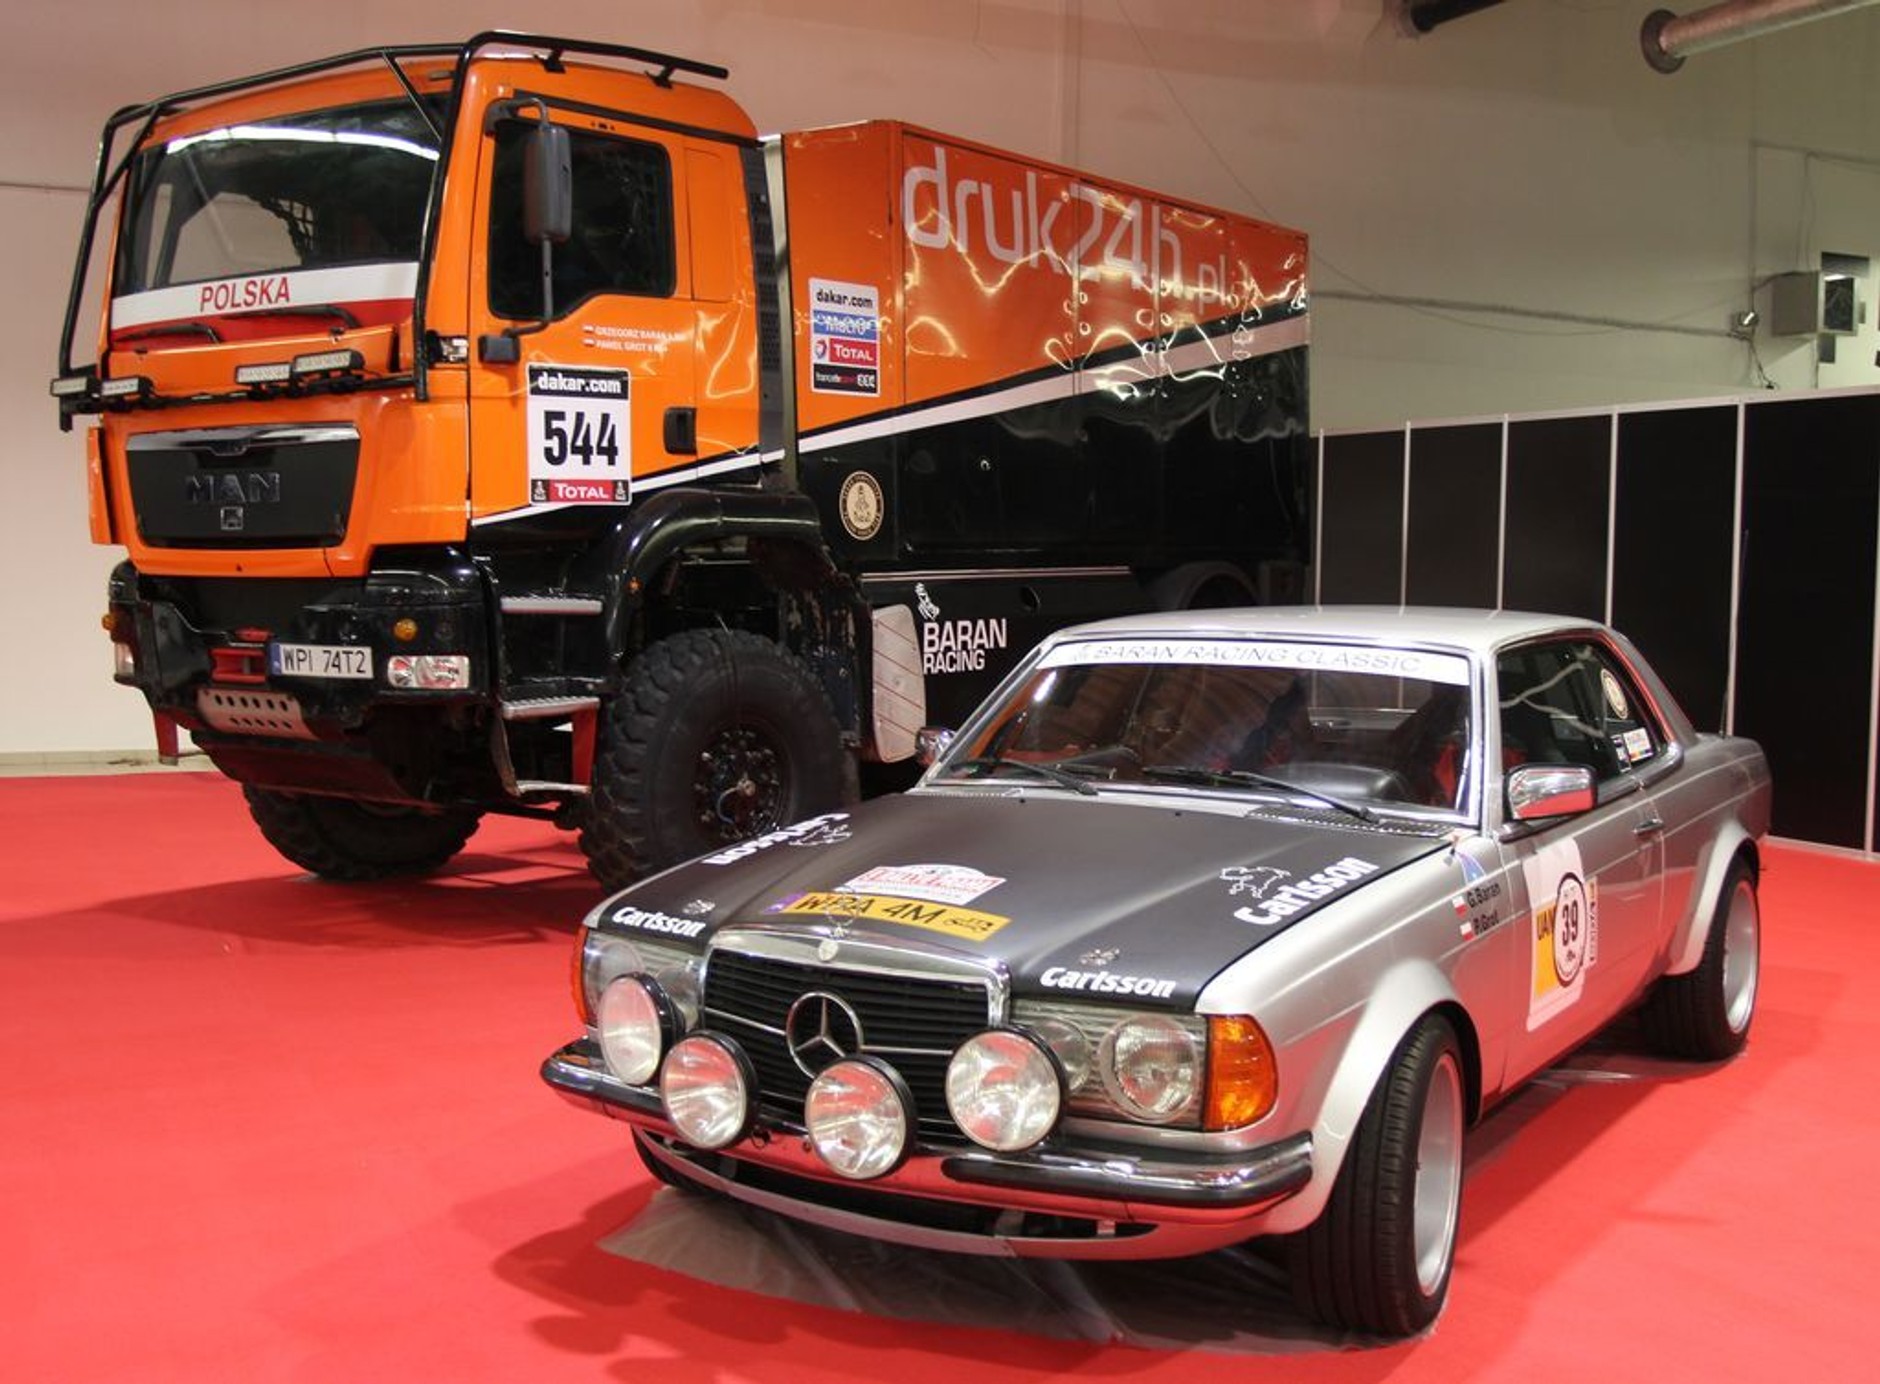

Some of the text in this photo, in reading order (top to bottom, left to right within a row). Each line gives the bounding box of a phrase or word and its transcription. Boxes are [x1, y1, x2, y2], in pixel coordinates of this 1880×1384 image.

[200, 276, 290, 312] POLSKA
[816, 289, 873, 308] dakar.com
[833, 343, 873, 361] TOTAL
[538, 371, 622, 394] dakar.com
[543, 410, 618, 466] 544
[184, 472, 281, 502] MAN
[555, 483, 609, 499] TOTAL
[923, 618, 1007, 653] BARAN
[283, 648, 366, 674] WPI 74T2
[923, 649, 985, 675] RACING
[1094, 644, 1421, 673] BARAN RACING CLASSIC
[1233, 857, 1380, 925] Carlsson
[612, 906, 706, 937] Carlsson
[882, 903, 947, 924] 4M
[1562, 900, 1578, 946] 39
[1039, 967, 1177, 998] Carlsson
